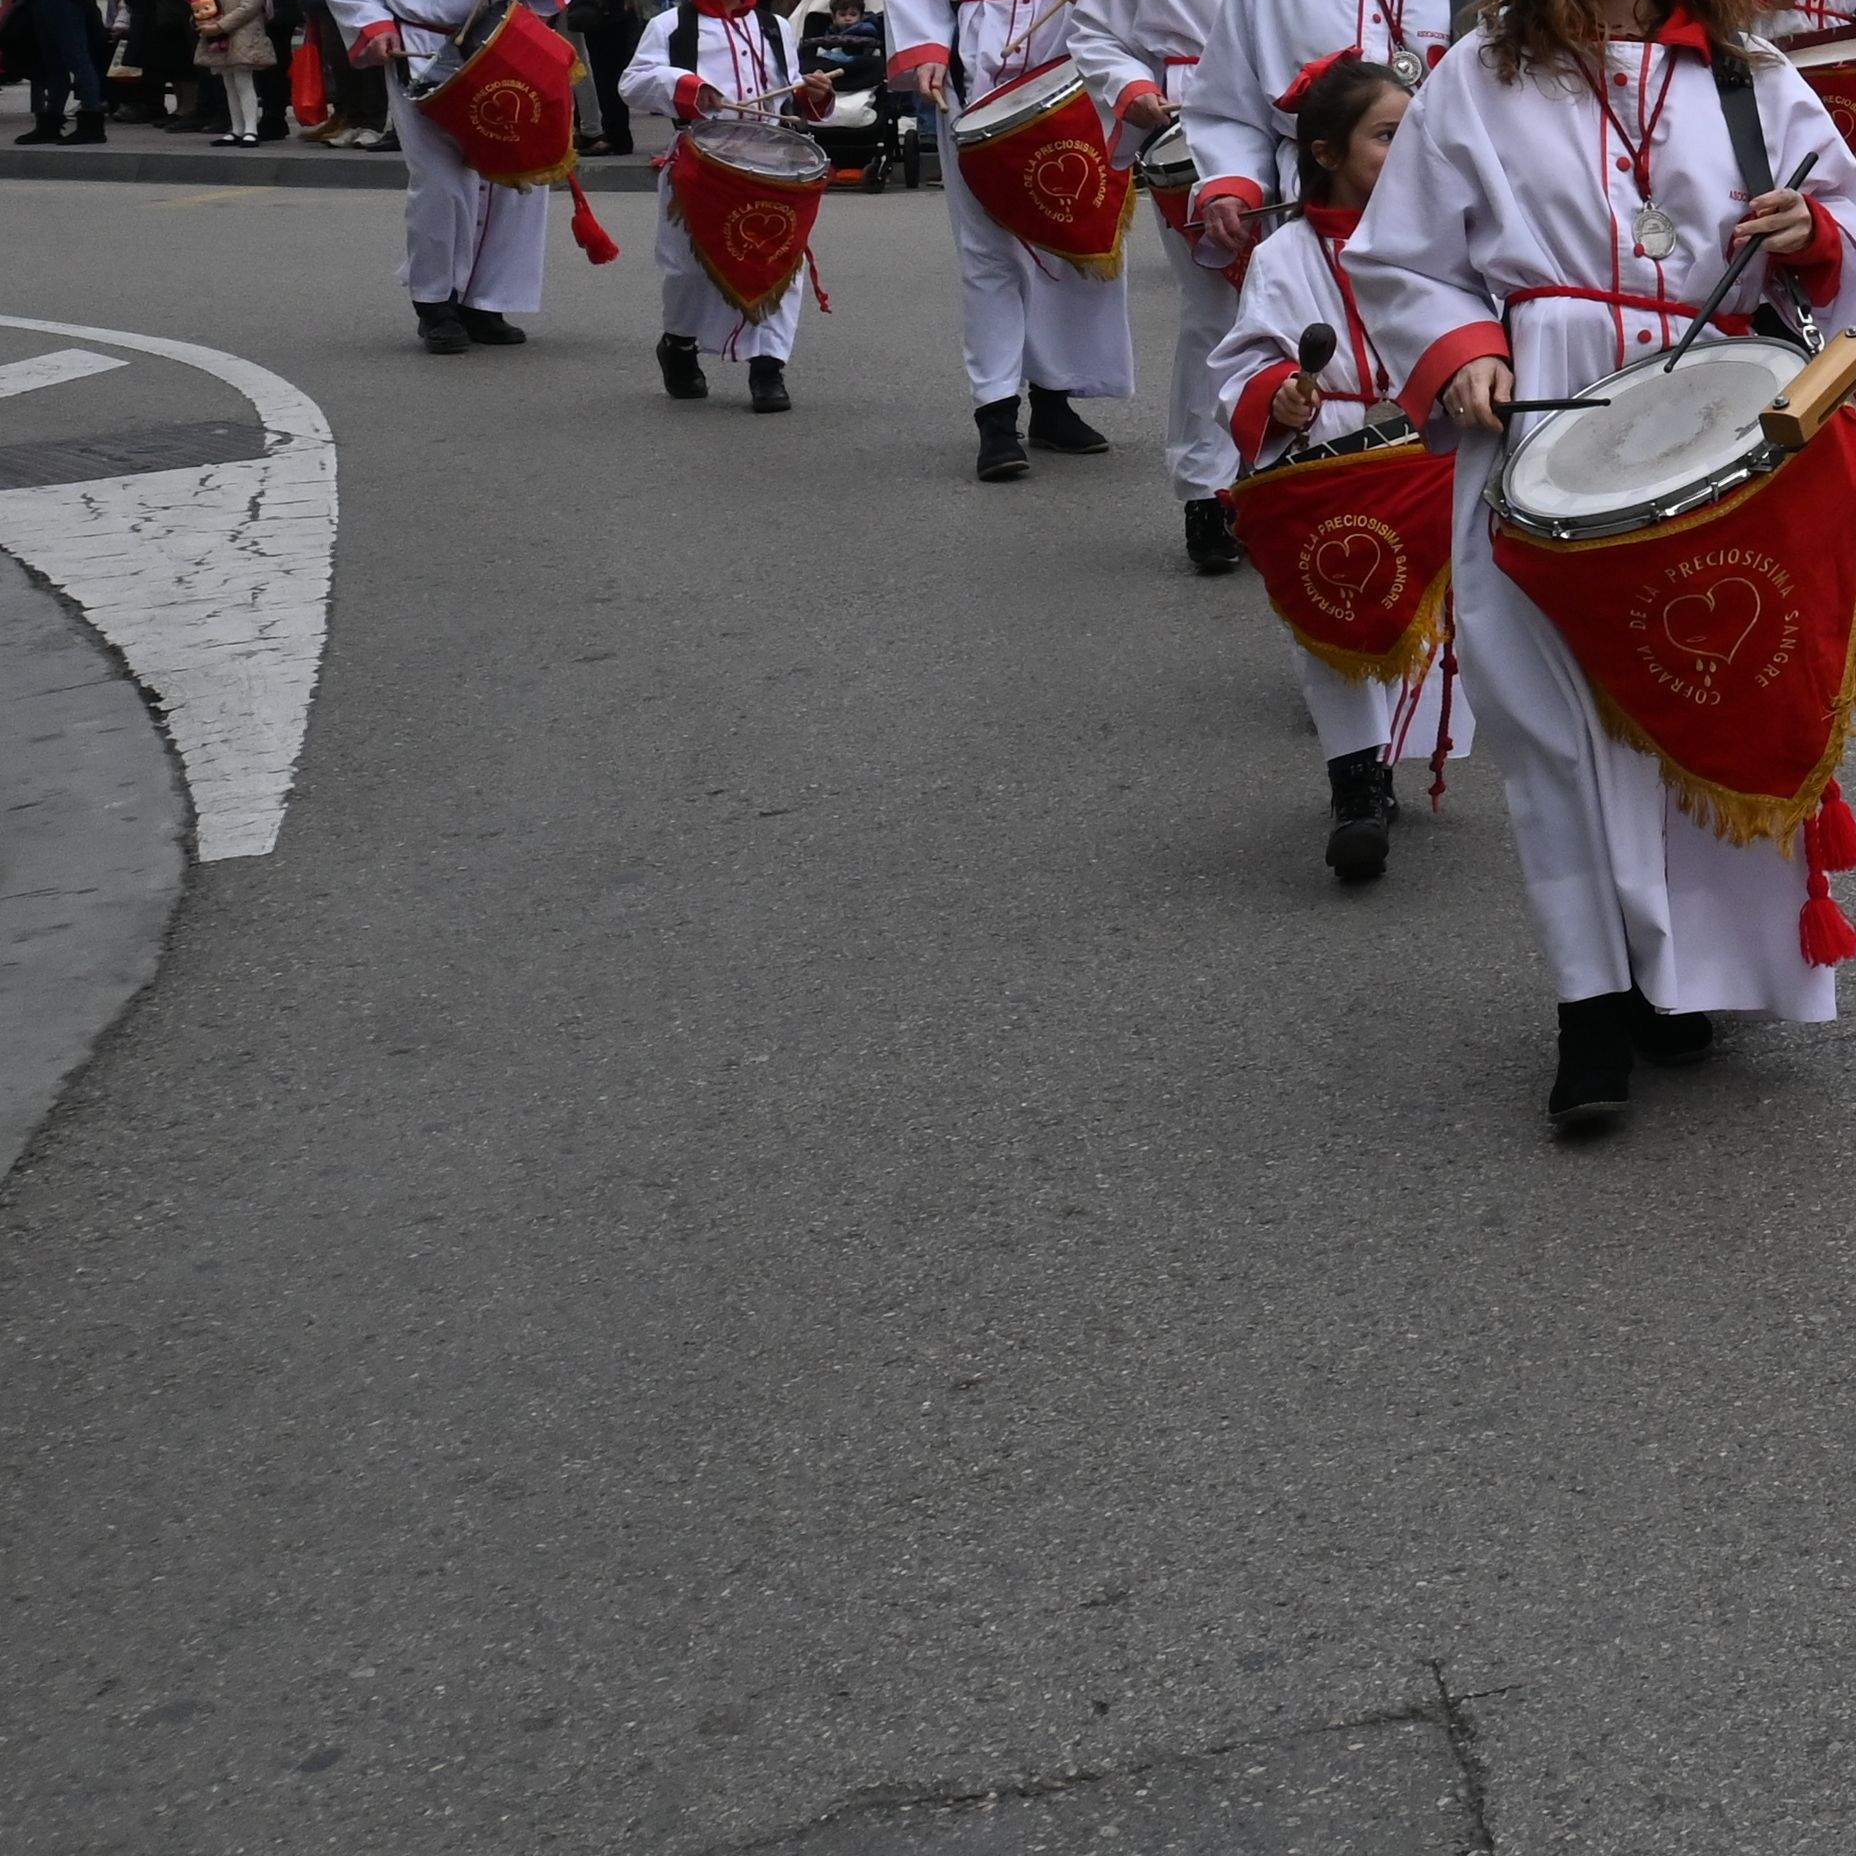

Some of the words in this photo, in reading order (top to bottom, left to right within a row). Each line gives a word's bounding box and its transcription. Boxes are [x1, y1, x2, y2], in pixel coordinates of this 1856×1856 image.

[1299, 551, 1311, 570] DE
[1303, 533, 1319, 552] LA
[1380, 554, 1408, 610] SANGRE
[1664, 547, 1796, 599] PRECIOSISIMA
[1635, 584, 1661, 604] LA
[1629, 609, 1647, 630] DE
[1754, 609, 1800, 688] SANGRE
[1636, 645, 1721, 705] COFRADIA
